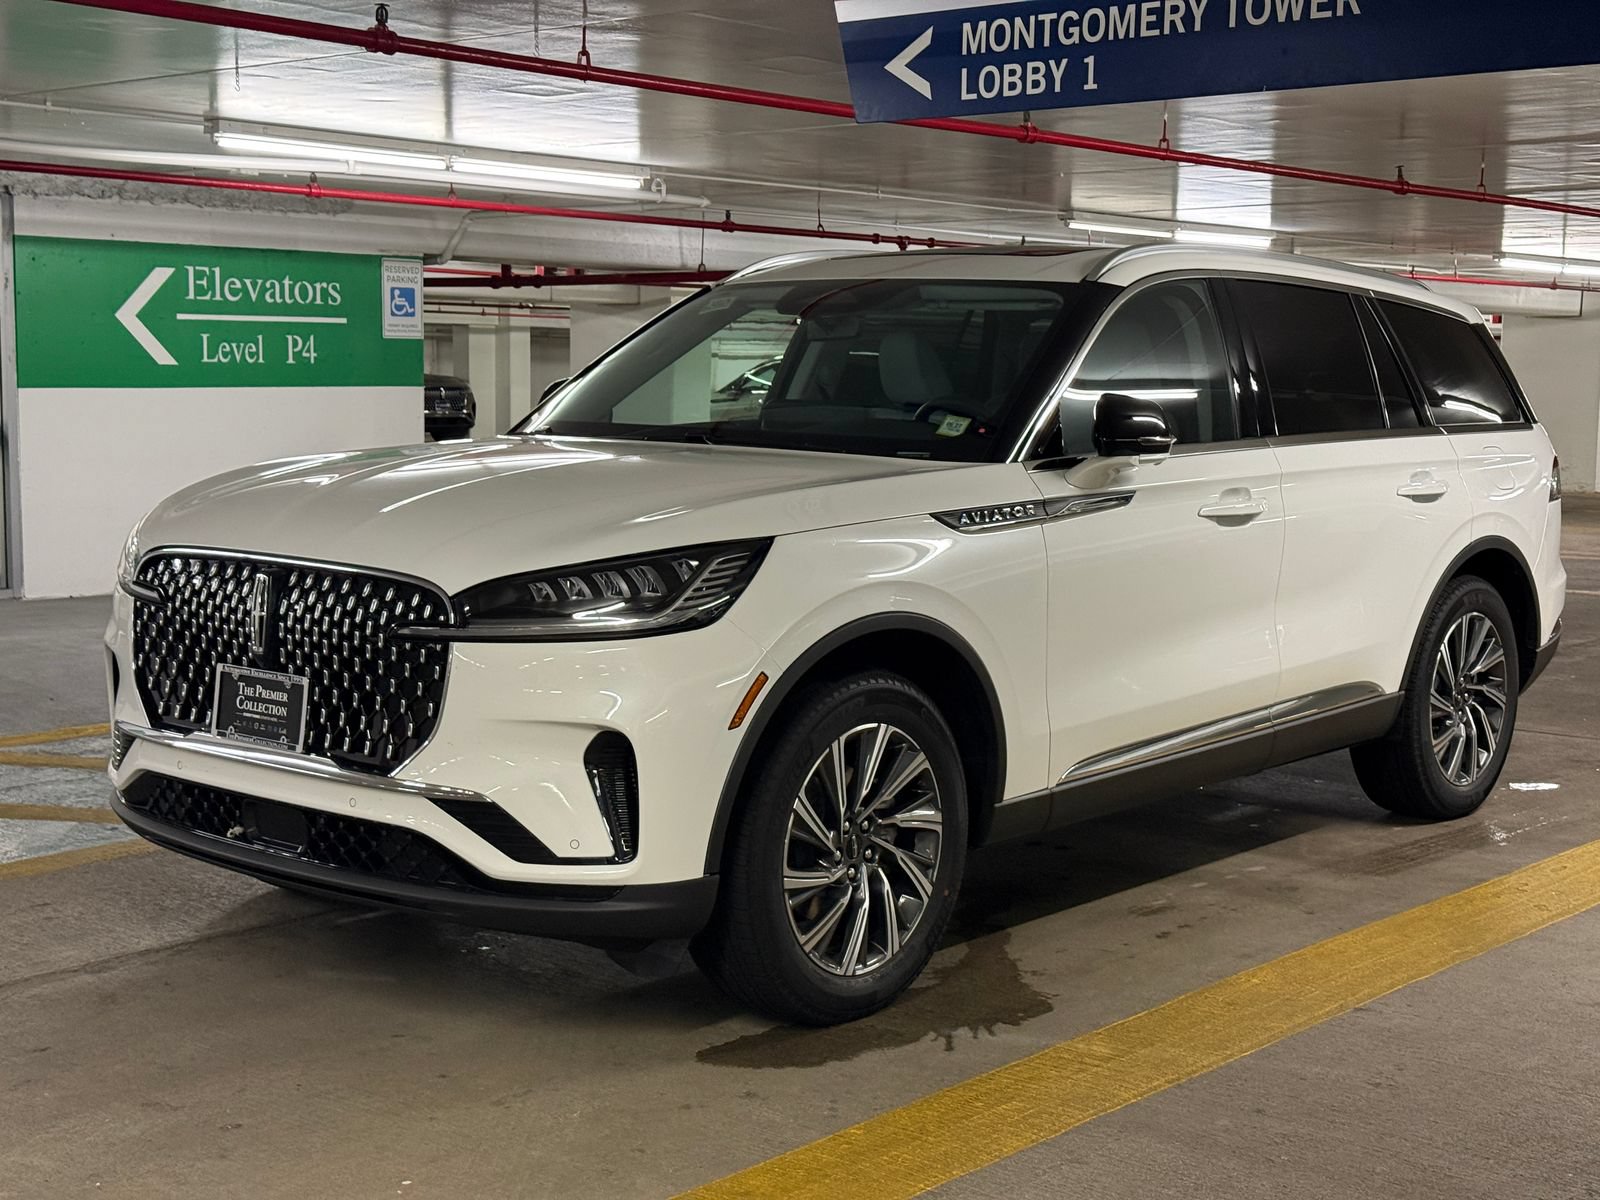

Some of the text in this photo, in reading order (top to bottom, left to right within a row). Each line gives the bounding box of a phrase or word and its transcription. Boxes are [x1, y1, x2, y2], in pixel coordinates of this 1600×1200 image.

[961, 0, 1208, 55] MONTGOMERY
[960, 55, 1098, 101] LOBBY 1
[384, 265, 420, 275] RESERVED
[386, 275, 419, 284] PARKING
[184, 265, 342, 305] Elevators
[201, 333, 318, 364] Level P4
[960, 504, 1036, 525] AVIATOR
[238, 682, 288, 702] THE PREMIER
[236, 695, 288, 717] COLLECTION
